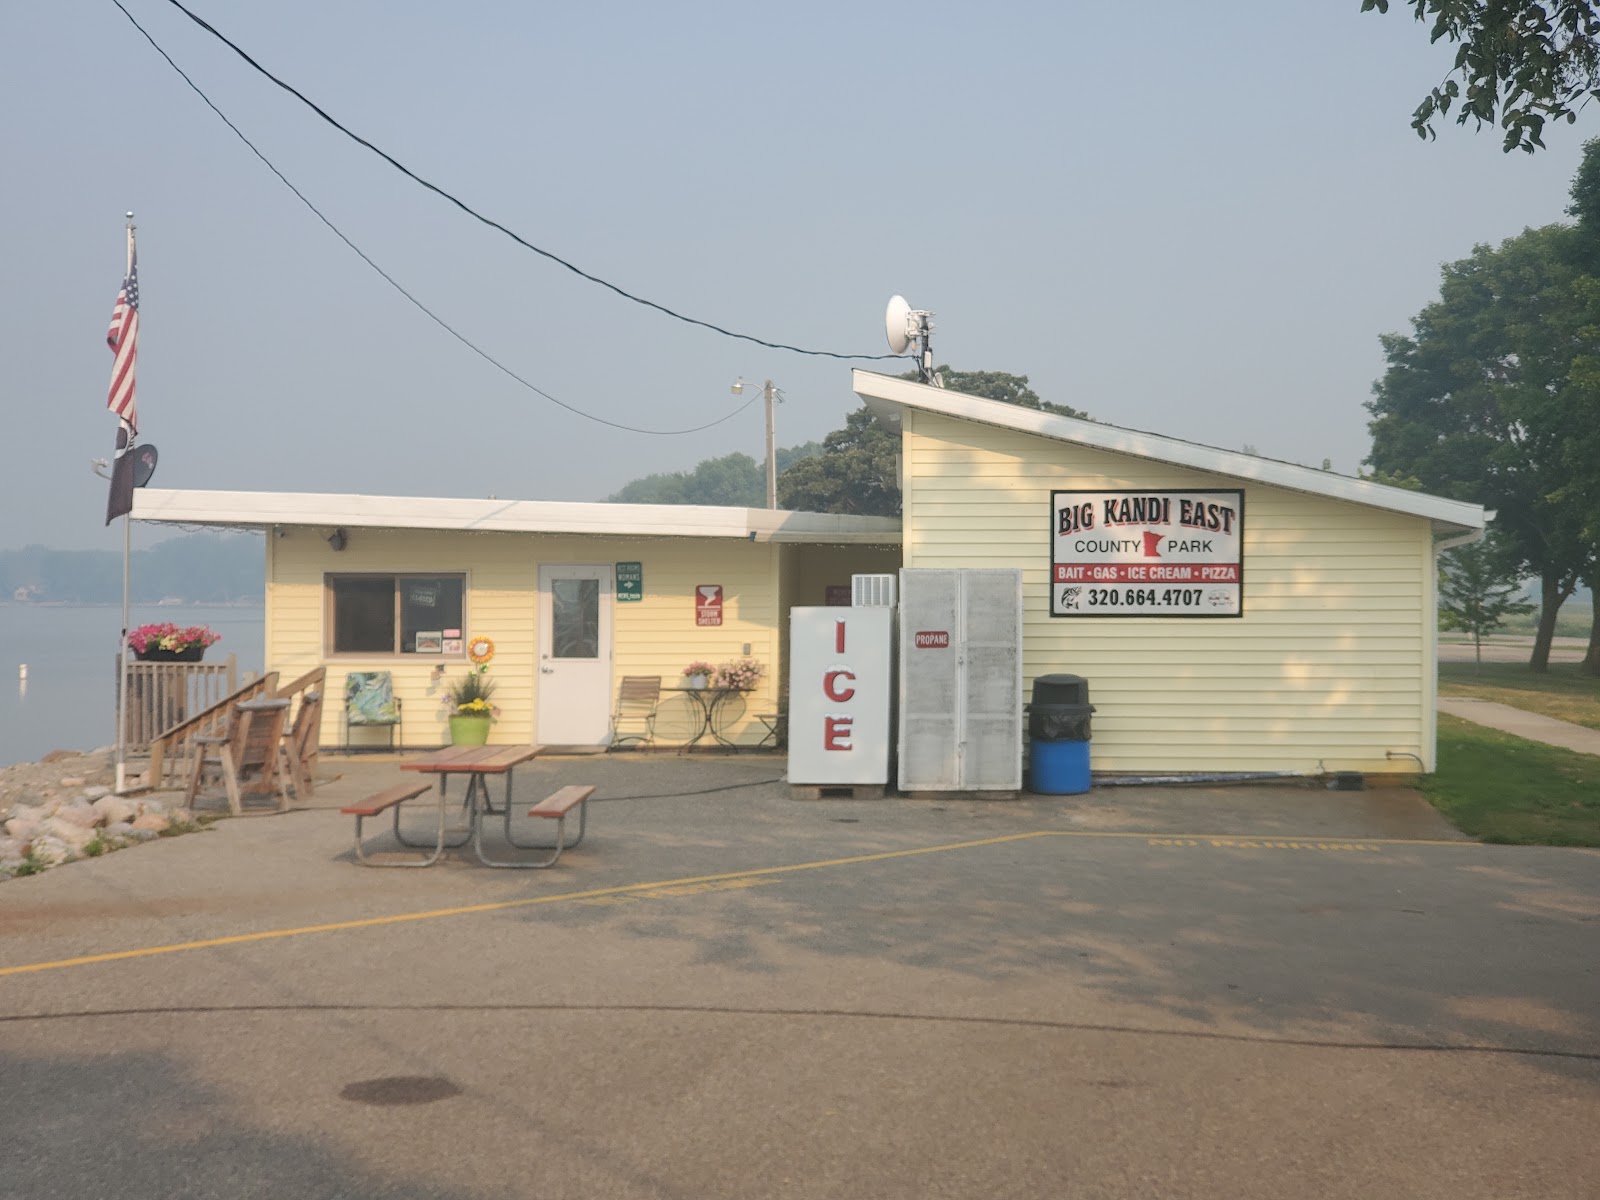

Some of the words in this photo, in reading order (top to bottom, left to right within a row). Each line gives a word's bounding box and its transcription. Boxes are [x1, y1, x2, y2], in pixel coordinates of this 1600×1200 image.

[1058, 503, 1094, 536] BIG
[1103, 497, 1170, 527] KANDI
[1180, 499, 1236, 535] EAST
[1074, 540, 1141, 553] COUNTY
[1168, 540, 1213, 553] PARK
[1058, 567, 1084, 579] BAIT
[1093, 567, 1117, 579] GAS
[1128, 567, 1146, 580] ICE
[1150, 567, 1191, 580] CREAM
[1202, 567, 1236, 580] PIZZA
[1088, 589, 1203, 606] 320.664.4707
[701, 610, 718, 618] STORM
[916, 634, 948, 645] PROPANE
[823, 616, 856, 751] ICE
